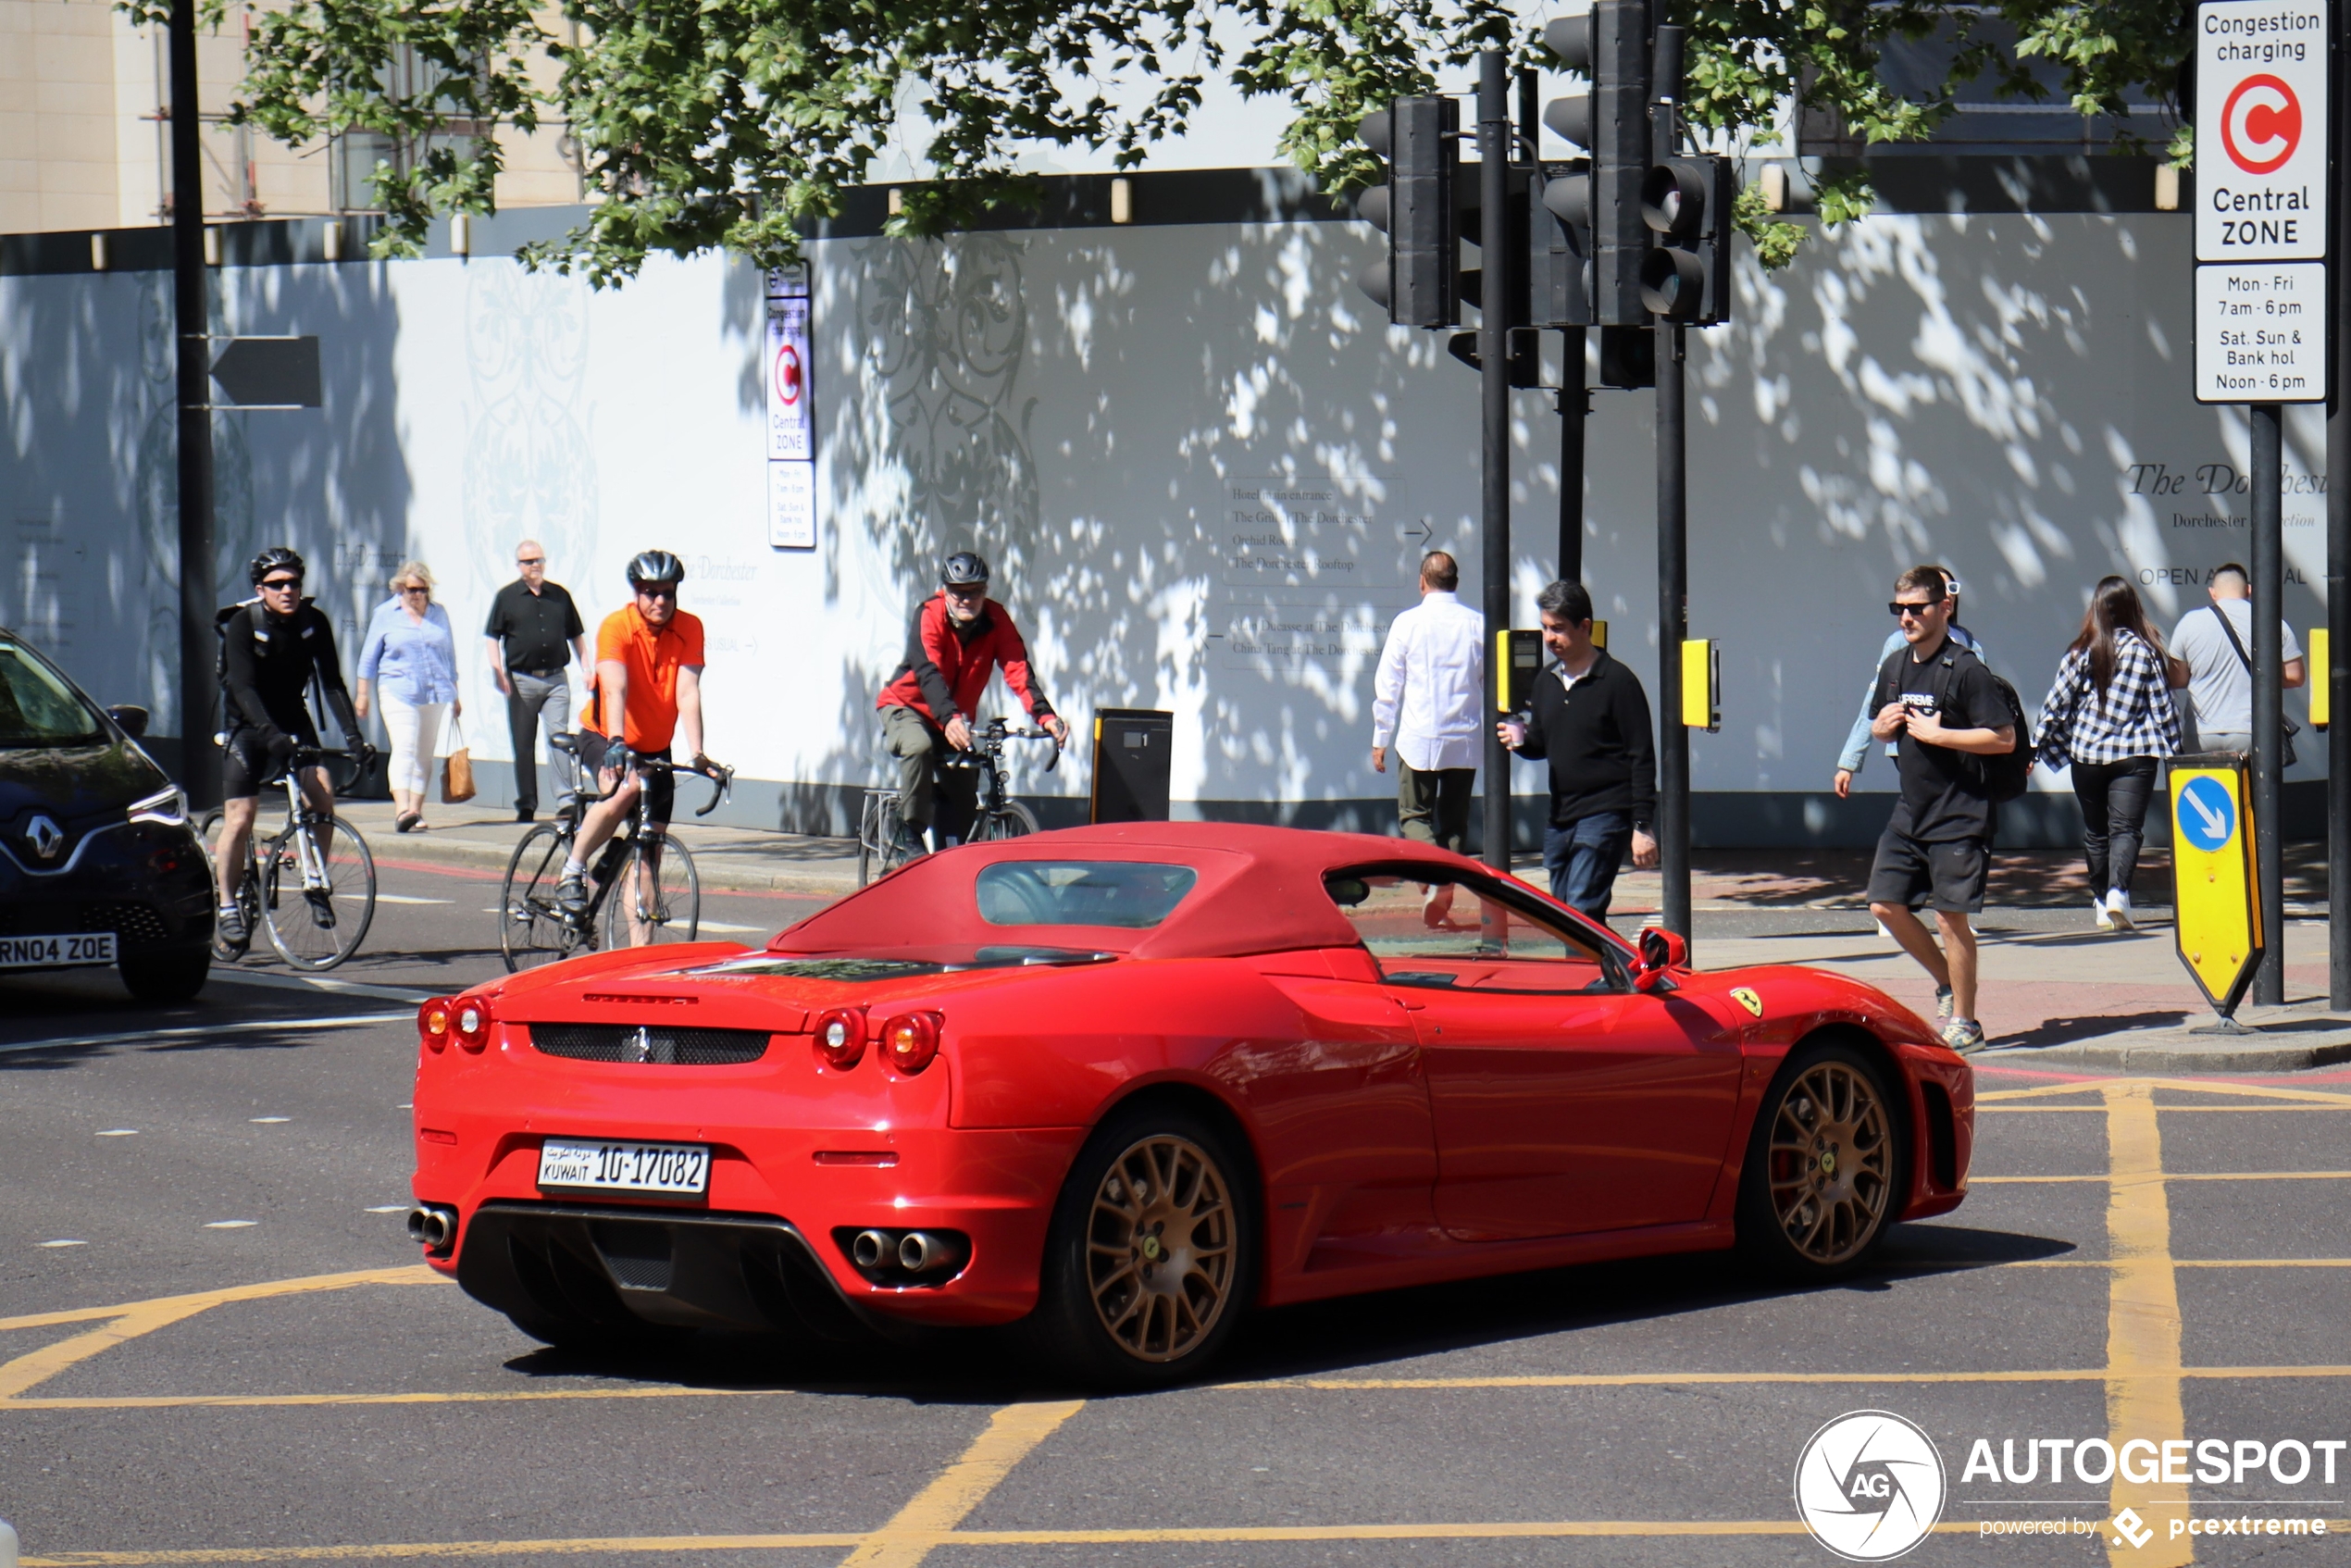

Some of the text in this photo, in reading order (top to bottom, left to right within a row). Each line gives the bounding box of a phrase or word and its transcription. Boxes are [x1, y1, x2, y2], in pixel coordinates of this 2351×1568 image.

[2205, 11, 2320, 37] Congestion
[2218, 40, 2306, 62] charging
[2213, 186, 2309, 212] Central
[2221, 219, 2298, 245] ZONE
[2227, 276, 2260, 292] Mon
[2273, 275, 2294, 292] Fri
[766, 306, 805, 322] Congestion
[2256, 330, 2285, 345] Sun
[2292, 330, 2302, 344] &
[2227, 350, 2295, 366] Bank hol
[2216, 374, 2257, 390] Noon
[773, 414, 805, 429] Central
[777, 435, 802, 450] ZONE
[2126, 463, 2185, 495] The
[1232, 488, 1332, 501] Hotel main entrance
[1233, 511, 1252, 523] The
[1256, 511, 1277, 524] Grill
[1293, 511, 1312, 524] The
[1316, 512, 1373, 525] Dorchester
[2173, 513, 2247, 529] Dorchester
[1233, 534, 1298, 546] Orchid Room
[698, 554, 758, 581] Dorchester
[1233, 557, 1354, 572] The Dorchester Rooftop
[2138, 568, 2198, 585] OPEN
[1261, 620, 1301, 632] Ducasse
[1303, 622, 1313, 632] at
[1316, 621, 1337, 632] The
[1340, 621, 1390, 633] Dorchest
[714, 637, 740, 652] USUAL
[1232, 642, 1262, 654] China
[1264, 642, 1289, 656] Tang
[1291, 644, 1301, 654] at
[1303, 643, 1325, 655] The
[68, 937, 111, 960] ZOE
[543, 1145, 703, 1188] KUWAIT 10-17082
